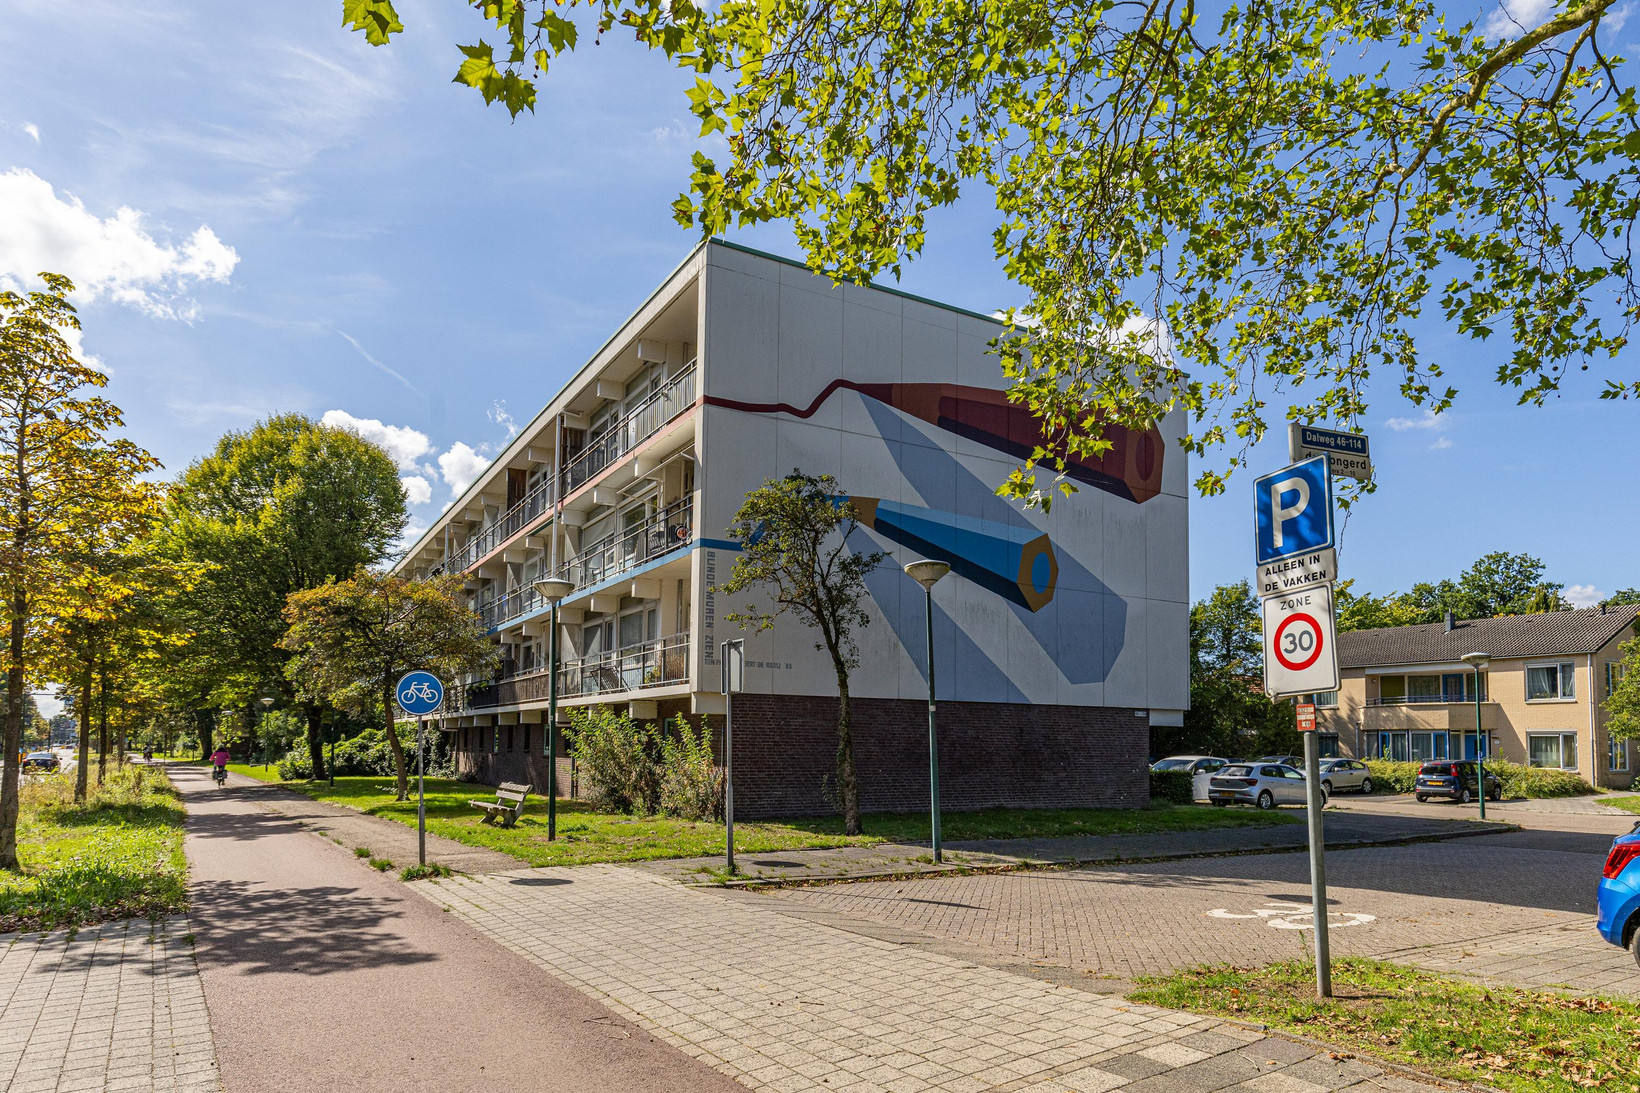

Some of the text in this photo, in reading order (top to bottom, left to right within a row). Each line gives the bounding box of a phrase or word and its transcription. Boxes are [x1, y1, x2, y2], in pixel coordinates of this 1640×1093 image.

[1306, 431, 1362, 449] Dalweg 46-114
[1330, 457, 1366, 470] ongerd
[1271, 477, 1310, 549] P
[1265, 554, 1320, 576] ALLEEN IN
[1265, 570, 1327, 592] DE VAKKEN
[704, 551, 715, 659] BLINDE MUREN ZIEN
[1280, 595, 1312, 610] ZONE
[1283, 629, 1314, 654] 30
